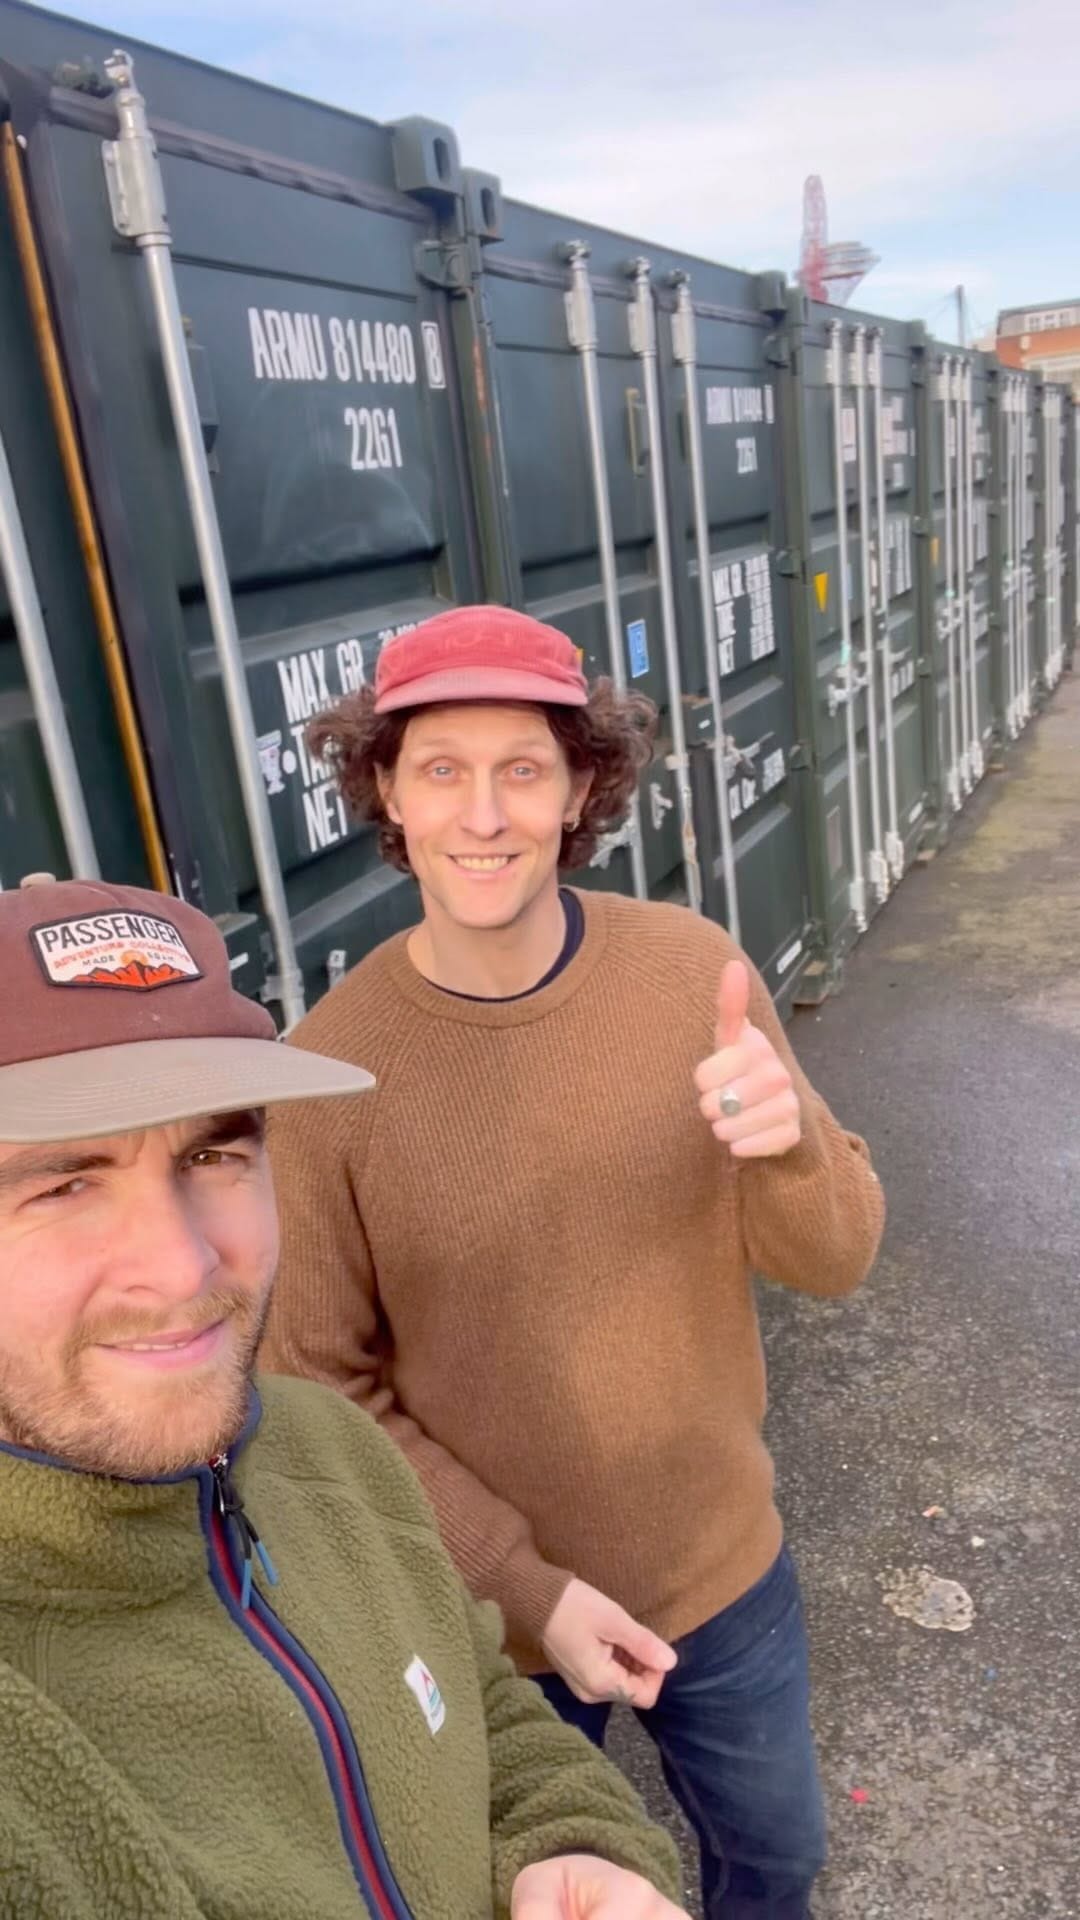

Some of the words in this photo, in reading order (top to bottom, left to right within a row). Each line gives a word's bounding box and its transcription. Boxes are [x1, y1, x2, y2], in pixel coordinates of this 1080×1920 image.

[248, 307, 328, 380] ARMU
[329, 317, 416, 384] 814480
[344, 407, 402, 470] 22G1
[41, 915, 182, 952] PASSENGER
